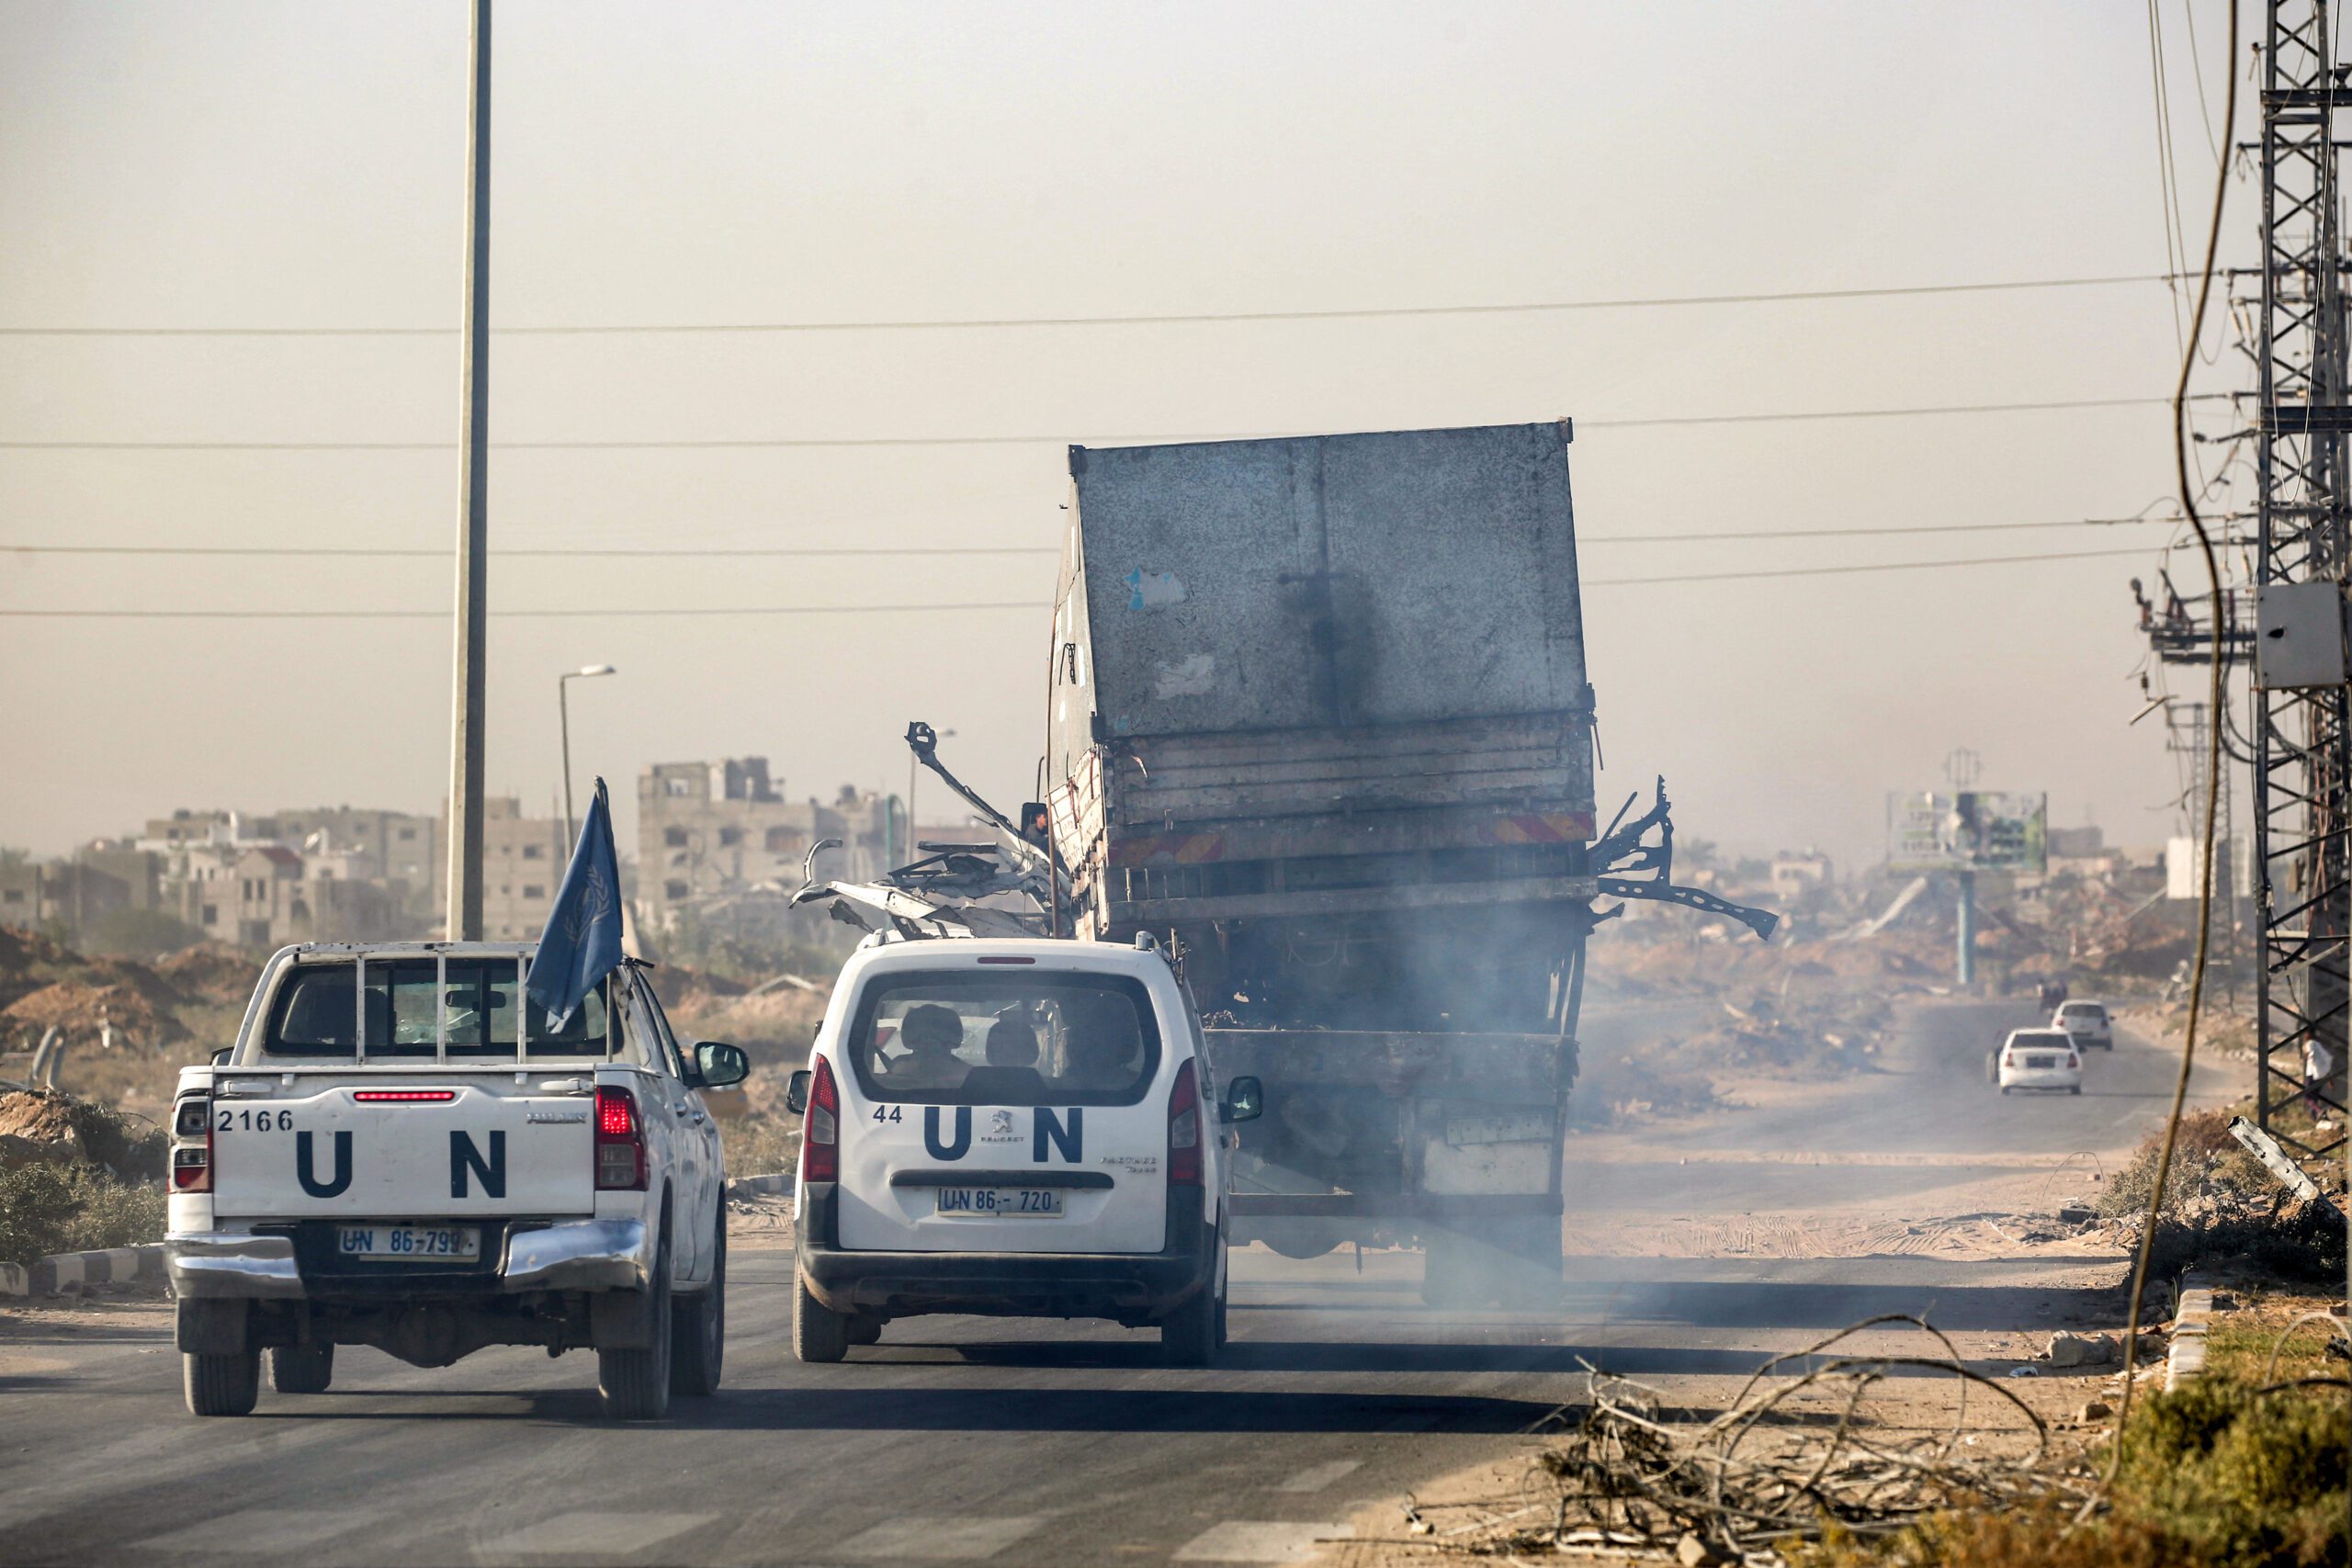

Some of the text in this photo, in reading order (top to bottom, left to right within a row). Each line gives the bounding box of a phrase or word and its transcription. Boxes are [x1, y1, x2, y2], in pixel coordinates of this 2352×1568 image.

[218, 1110, 293, 1132] 2166
[873, 1105, 902, 1123] 44
[944, 1190, 971, 1210] UN
[342, 1230, 373, 1252] UN
